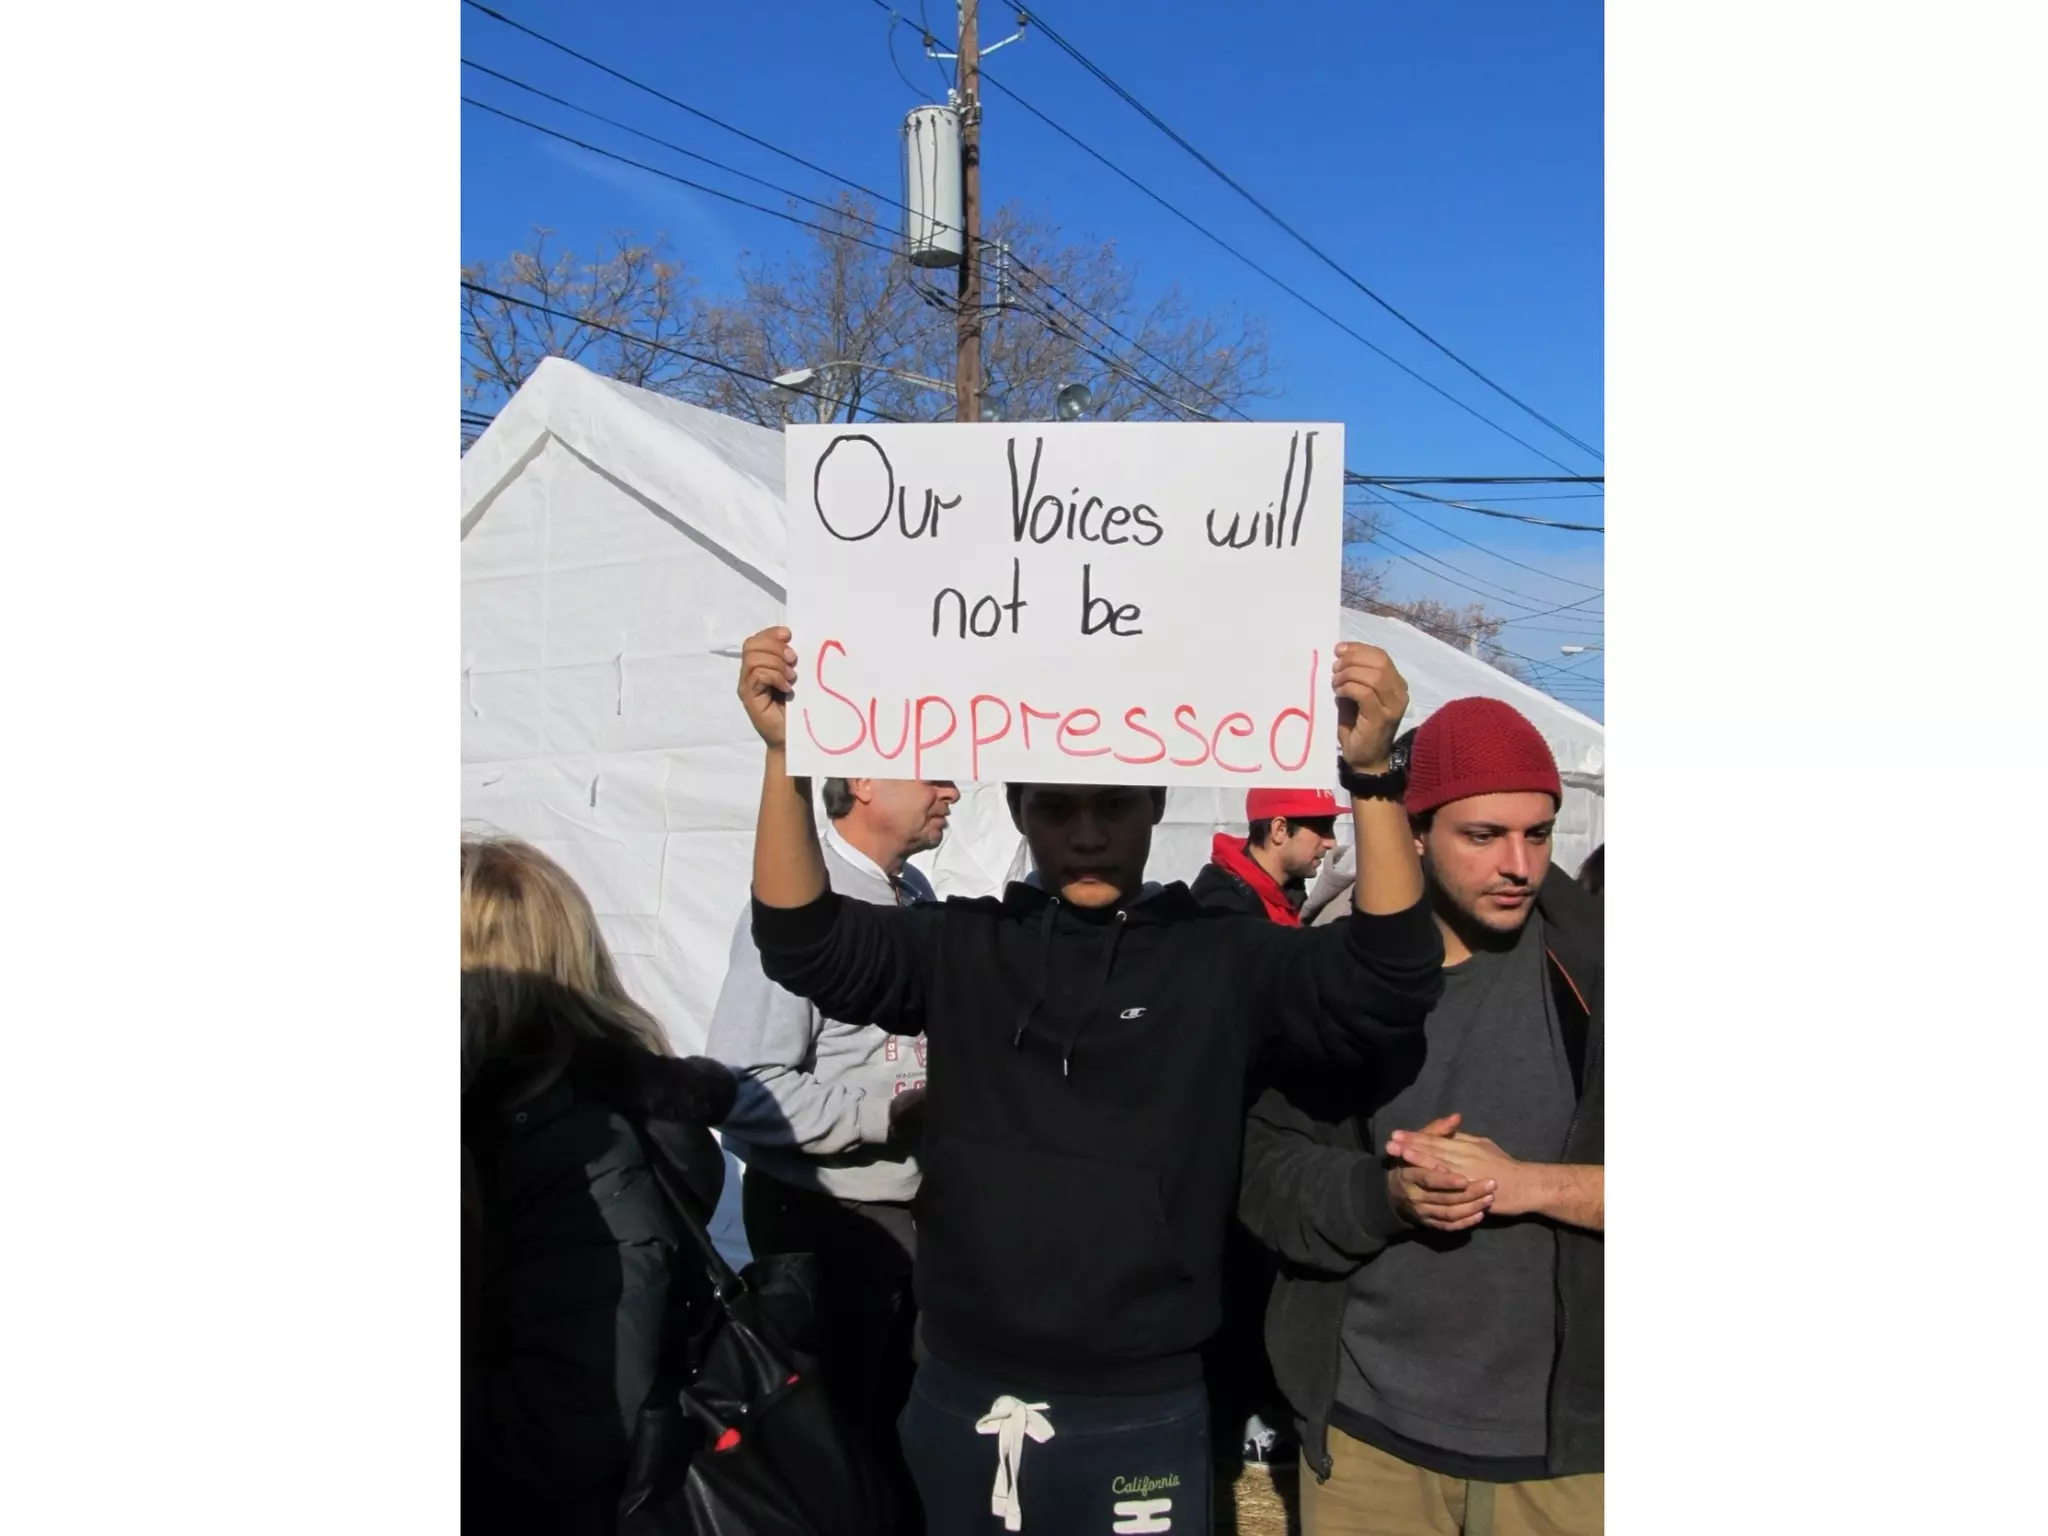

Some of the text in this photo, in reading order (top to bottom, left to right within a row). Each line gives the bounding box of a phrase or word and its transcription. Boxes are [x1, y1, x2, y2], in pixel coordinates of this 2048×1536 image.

[813, 431, 1320, 549] Our Voices will
[932, 558, 1143, 639] not be
[803, 640, 1319, 780] Suppressed
[1111, 1473, 1180, 1497] California
